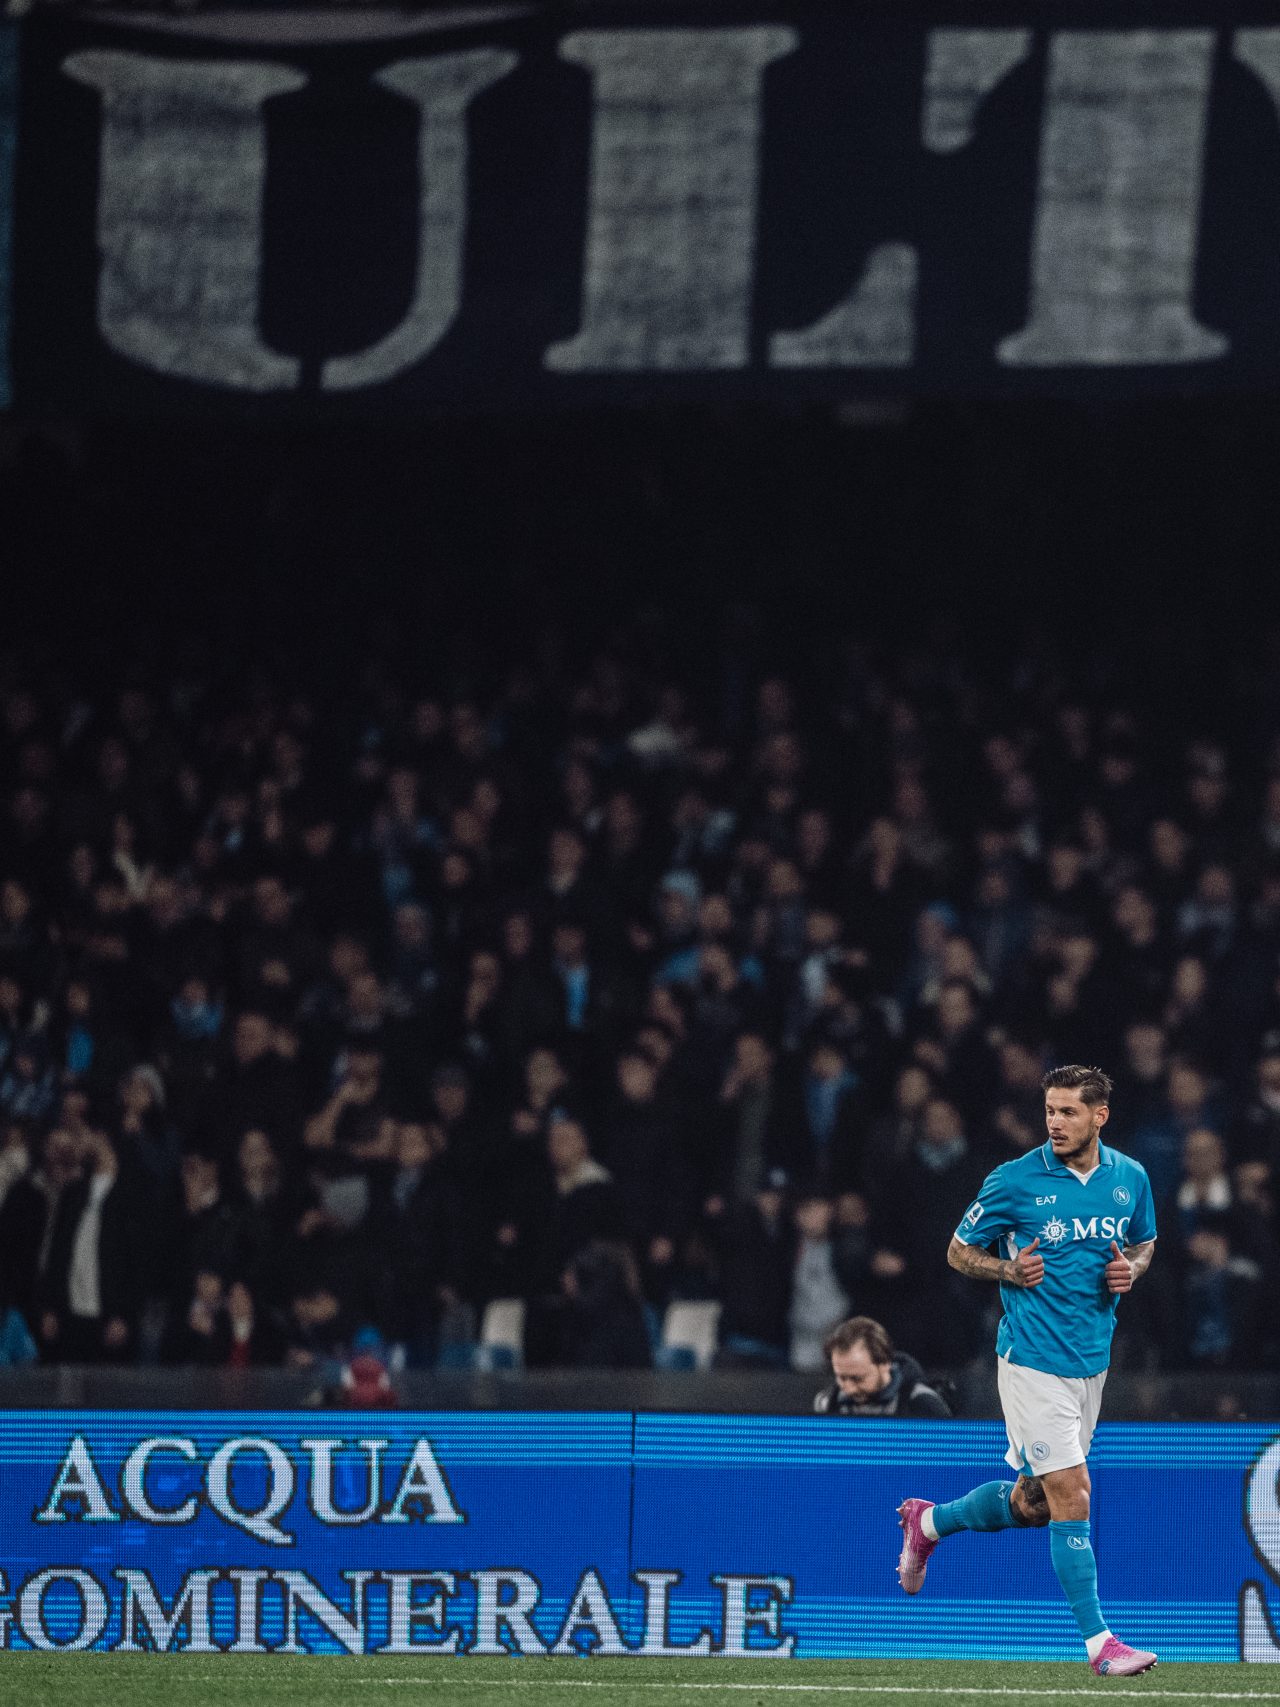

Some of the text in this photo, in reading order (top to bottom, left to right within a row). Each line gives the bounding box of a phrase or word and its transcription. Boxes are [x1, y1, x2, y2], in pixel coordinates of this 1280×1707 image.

[1036, 1195, 1057, 1206] EA7
[1071, 1216, 1131, 1241] MSC
[35, 1435, 466, 1545] ACQUA
[0, 1567, 795, 1658] OMINERALE
